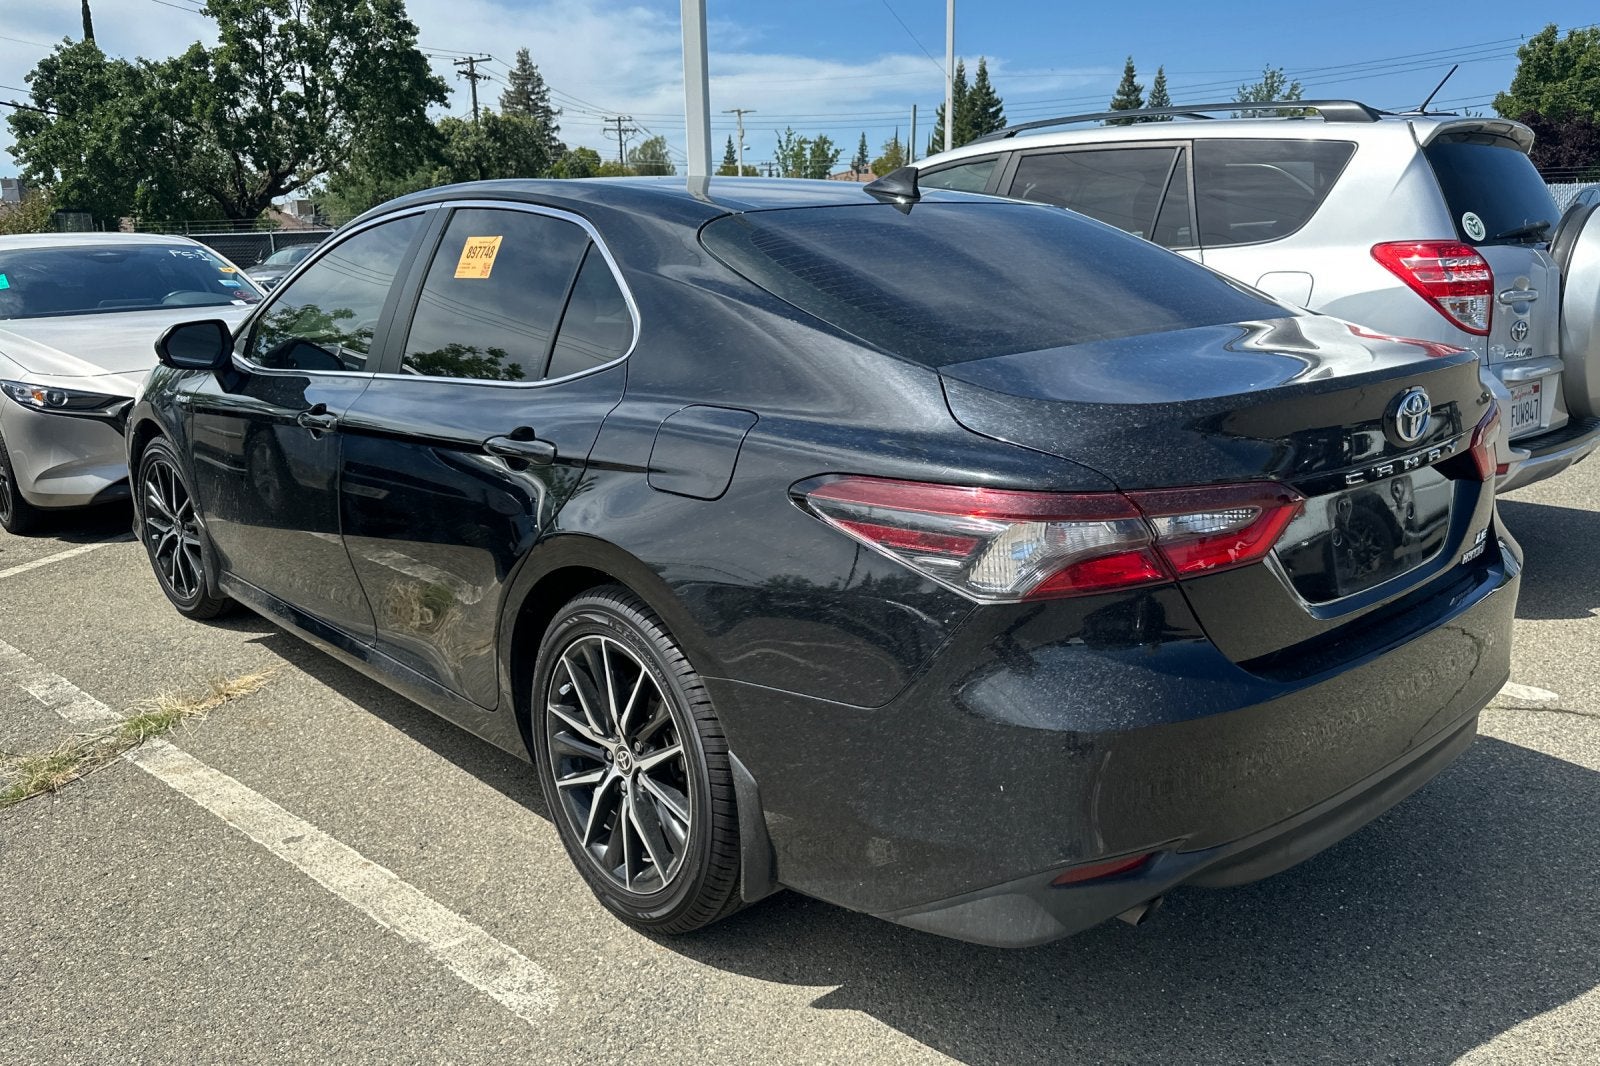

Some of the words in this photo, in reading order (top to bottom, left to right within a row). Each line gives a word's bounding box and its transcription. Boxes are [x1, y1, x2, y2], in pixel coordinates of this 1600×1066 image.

[466, 245, 496, 259] 897748
[1511, 399, 1539, 427] FUW847
[1345, 440, 1458, 484] CAMRY
